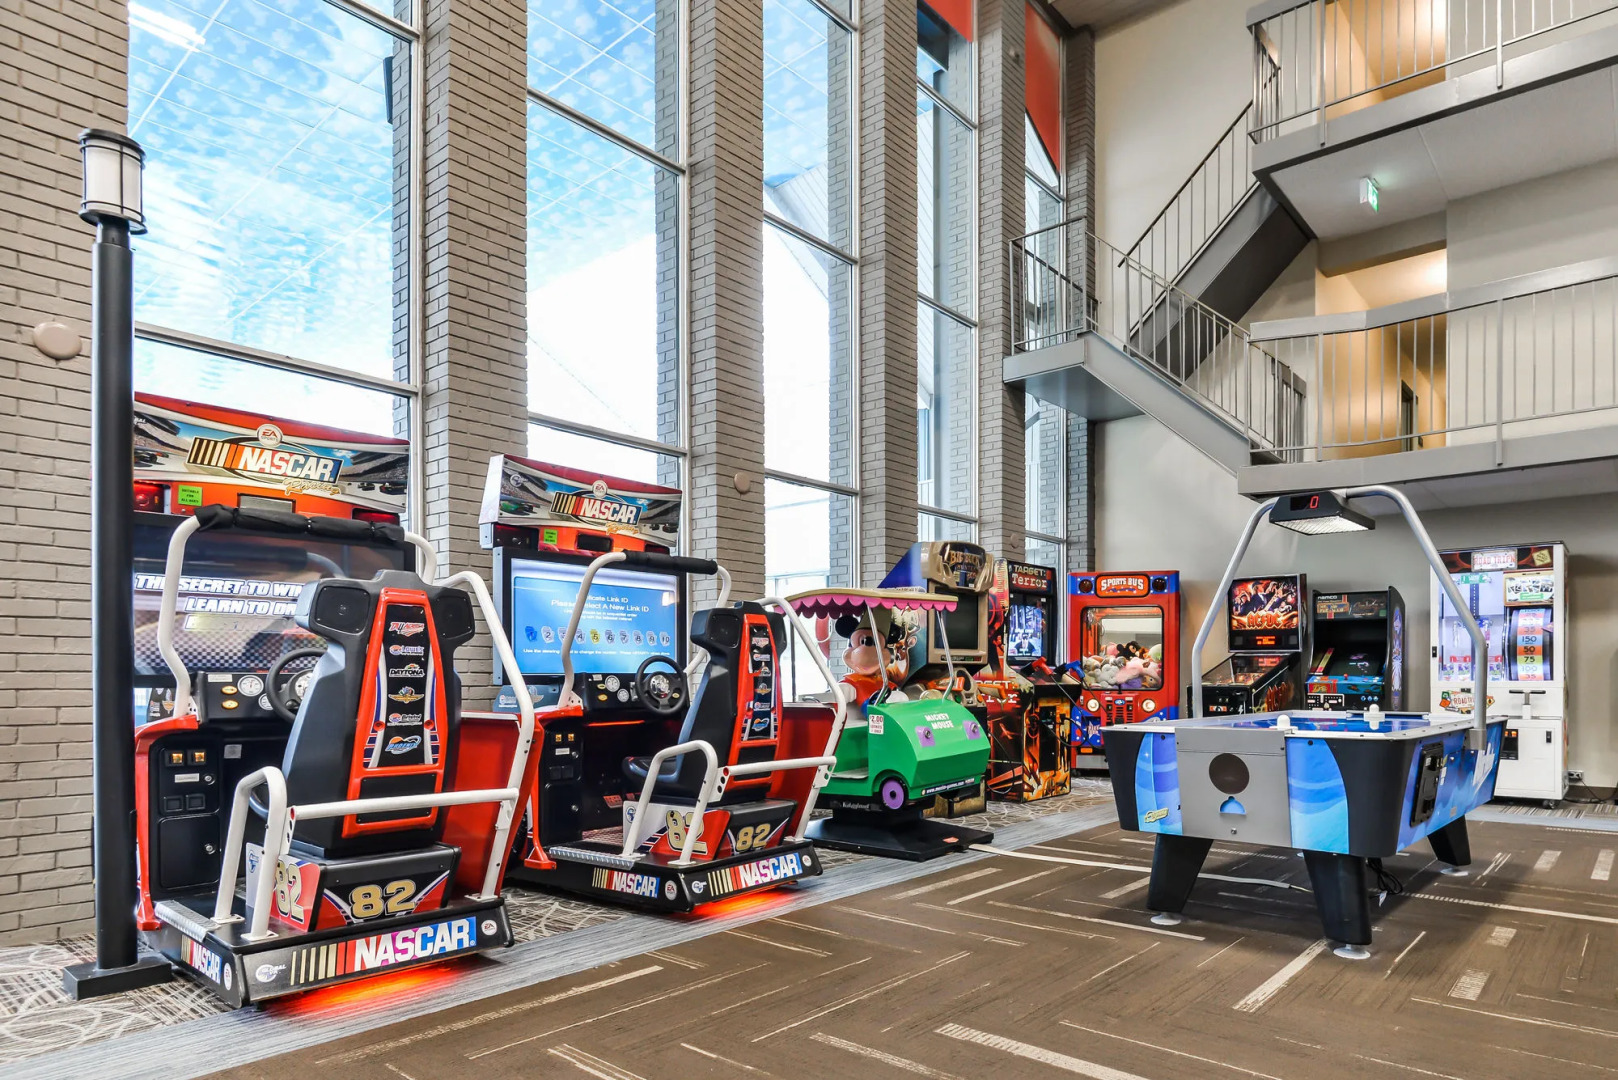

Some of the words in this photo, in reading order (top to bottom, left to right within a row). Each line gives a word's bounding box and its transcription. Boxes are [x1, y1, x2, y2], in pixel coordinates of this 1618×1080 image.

[262, 429, 278, 438] EA
[238, 447, 334, 482] NASCAR
[283, 479, 341, 496] Racing
[580, 498, 637, 525] NASCAR
[949, 551, 964, 565] BIG
[1473, 555, 1490, 565] ROAD
[178, 577, 245, 595] SECRET
[247, 581, 271, 596] TO
[1012, 573, 1048, 588] Terror
[1101, 578, 1127, 591] SPORTS
[1128, 578, 1144, 590] BUS
[185, 597, 245, 613] LEARN
[247, 600, 271, 615] TO
[610, 603, 625, 611] New
[626, 604, 641, 612] Link
[1521, 635, 1537, 643] 150
[1523, 645, 1536, 653] 50
[1453, 697, 1467, 705] ROAD
[925, 713, 950, 722] MICKEY
[930, 720, 954, 729] MOUSE
[666, 810, 708, 855] 82
[736, 823, 771, 852] 82
[738, 855, 799, 889] NASCAR
[275, 860, 304, 924] 82
[612, 872, 657, 898] NASCAR
[666, 884, 675, 892] EA
[350, 880, 416, 920] 82
[354, 918, 470, 971] NASCAR
[193, 941, 221, 984] NASCAR
